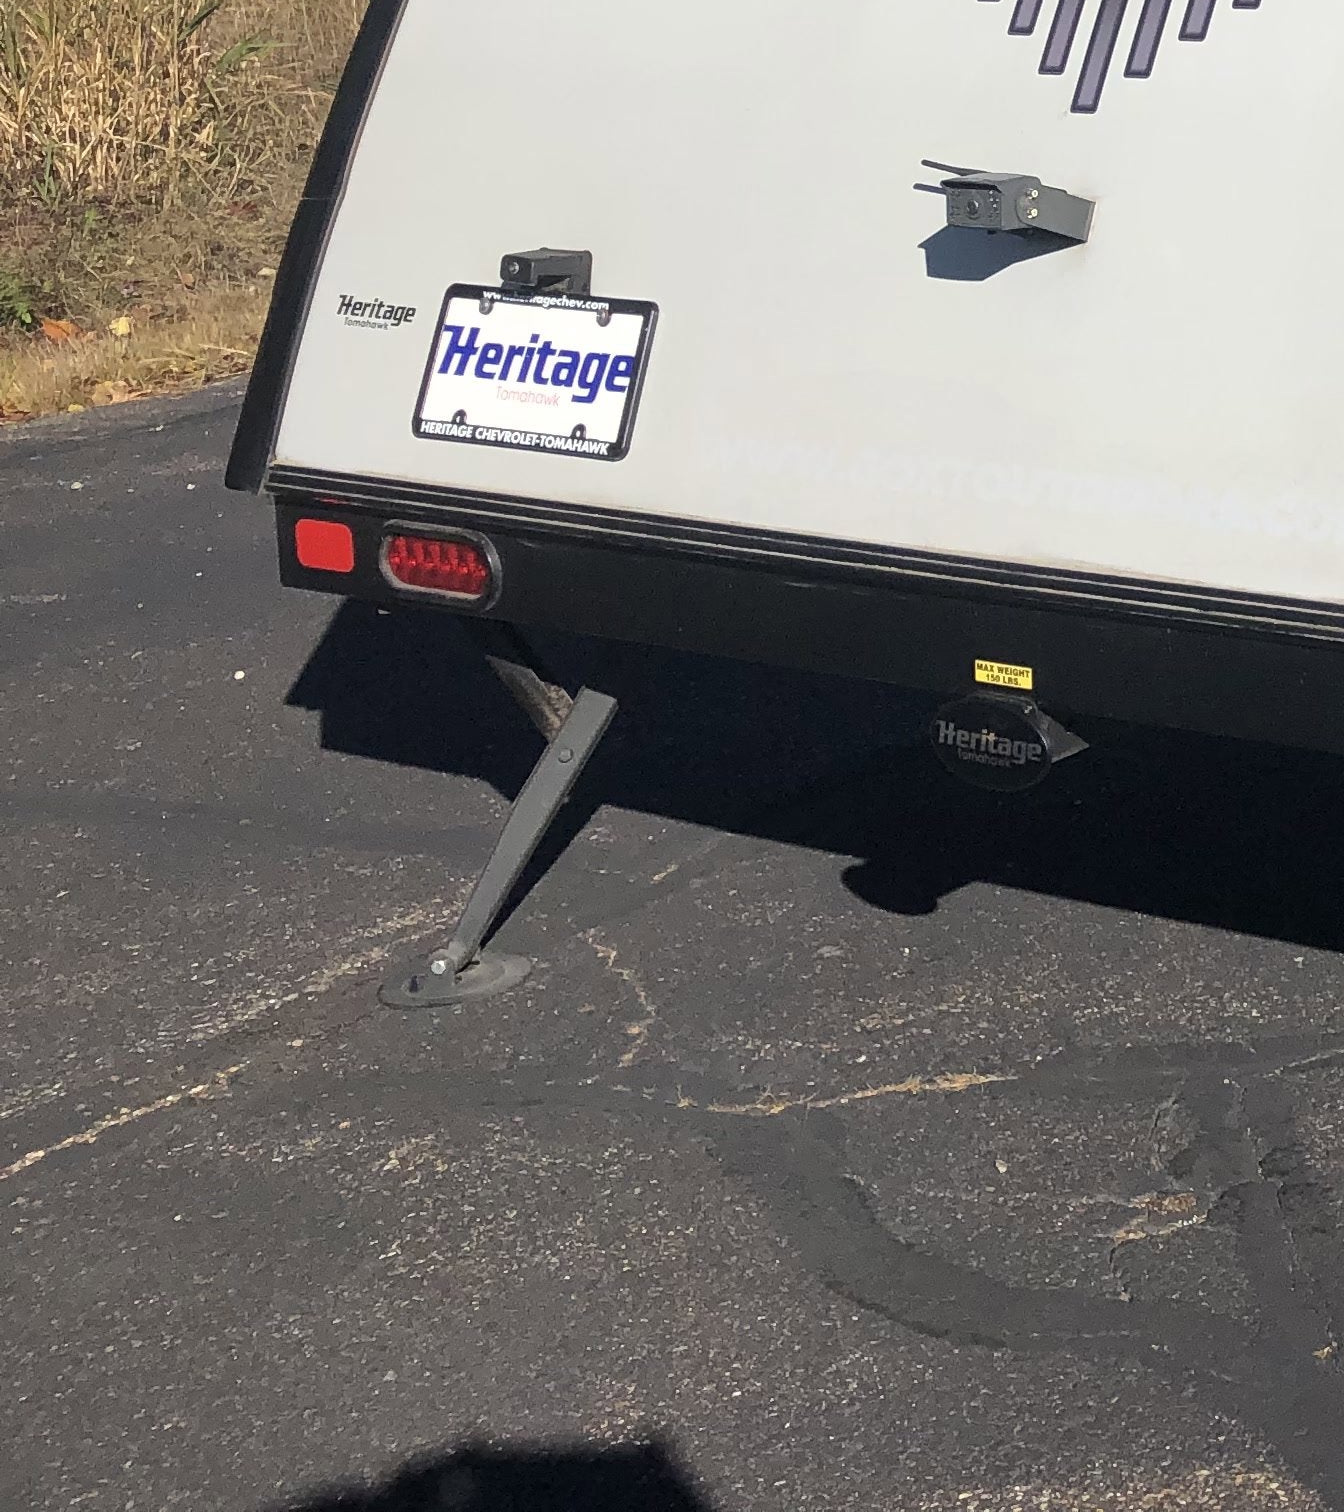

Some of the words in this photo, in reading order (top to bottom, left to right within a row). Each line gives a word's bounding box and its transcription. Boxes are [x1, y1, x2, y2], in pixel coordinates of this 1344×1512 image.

[336, 293, 416, 327] Heritage
[437, 324, 636, 404] Heritage
[496, 386, 561, 407] Tomahawk
[420, 420, 473, 439] HERITAGE
[475, 427, 610, 456] CHEVROLET-TOMAHAWK
[976, 662, 995, 674] MAX
[997, 666, 1030, 678] WEIGHT
[1003, 675, 1022, 686] LBS.
[936, 720, 1042, 764] Heritage
